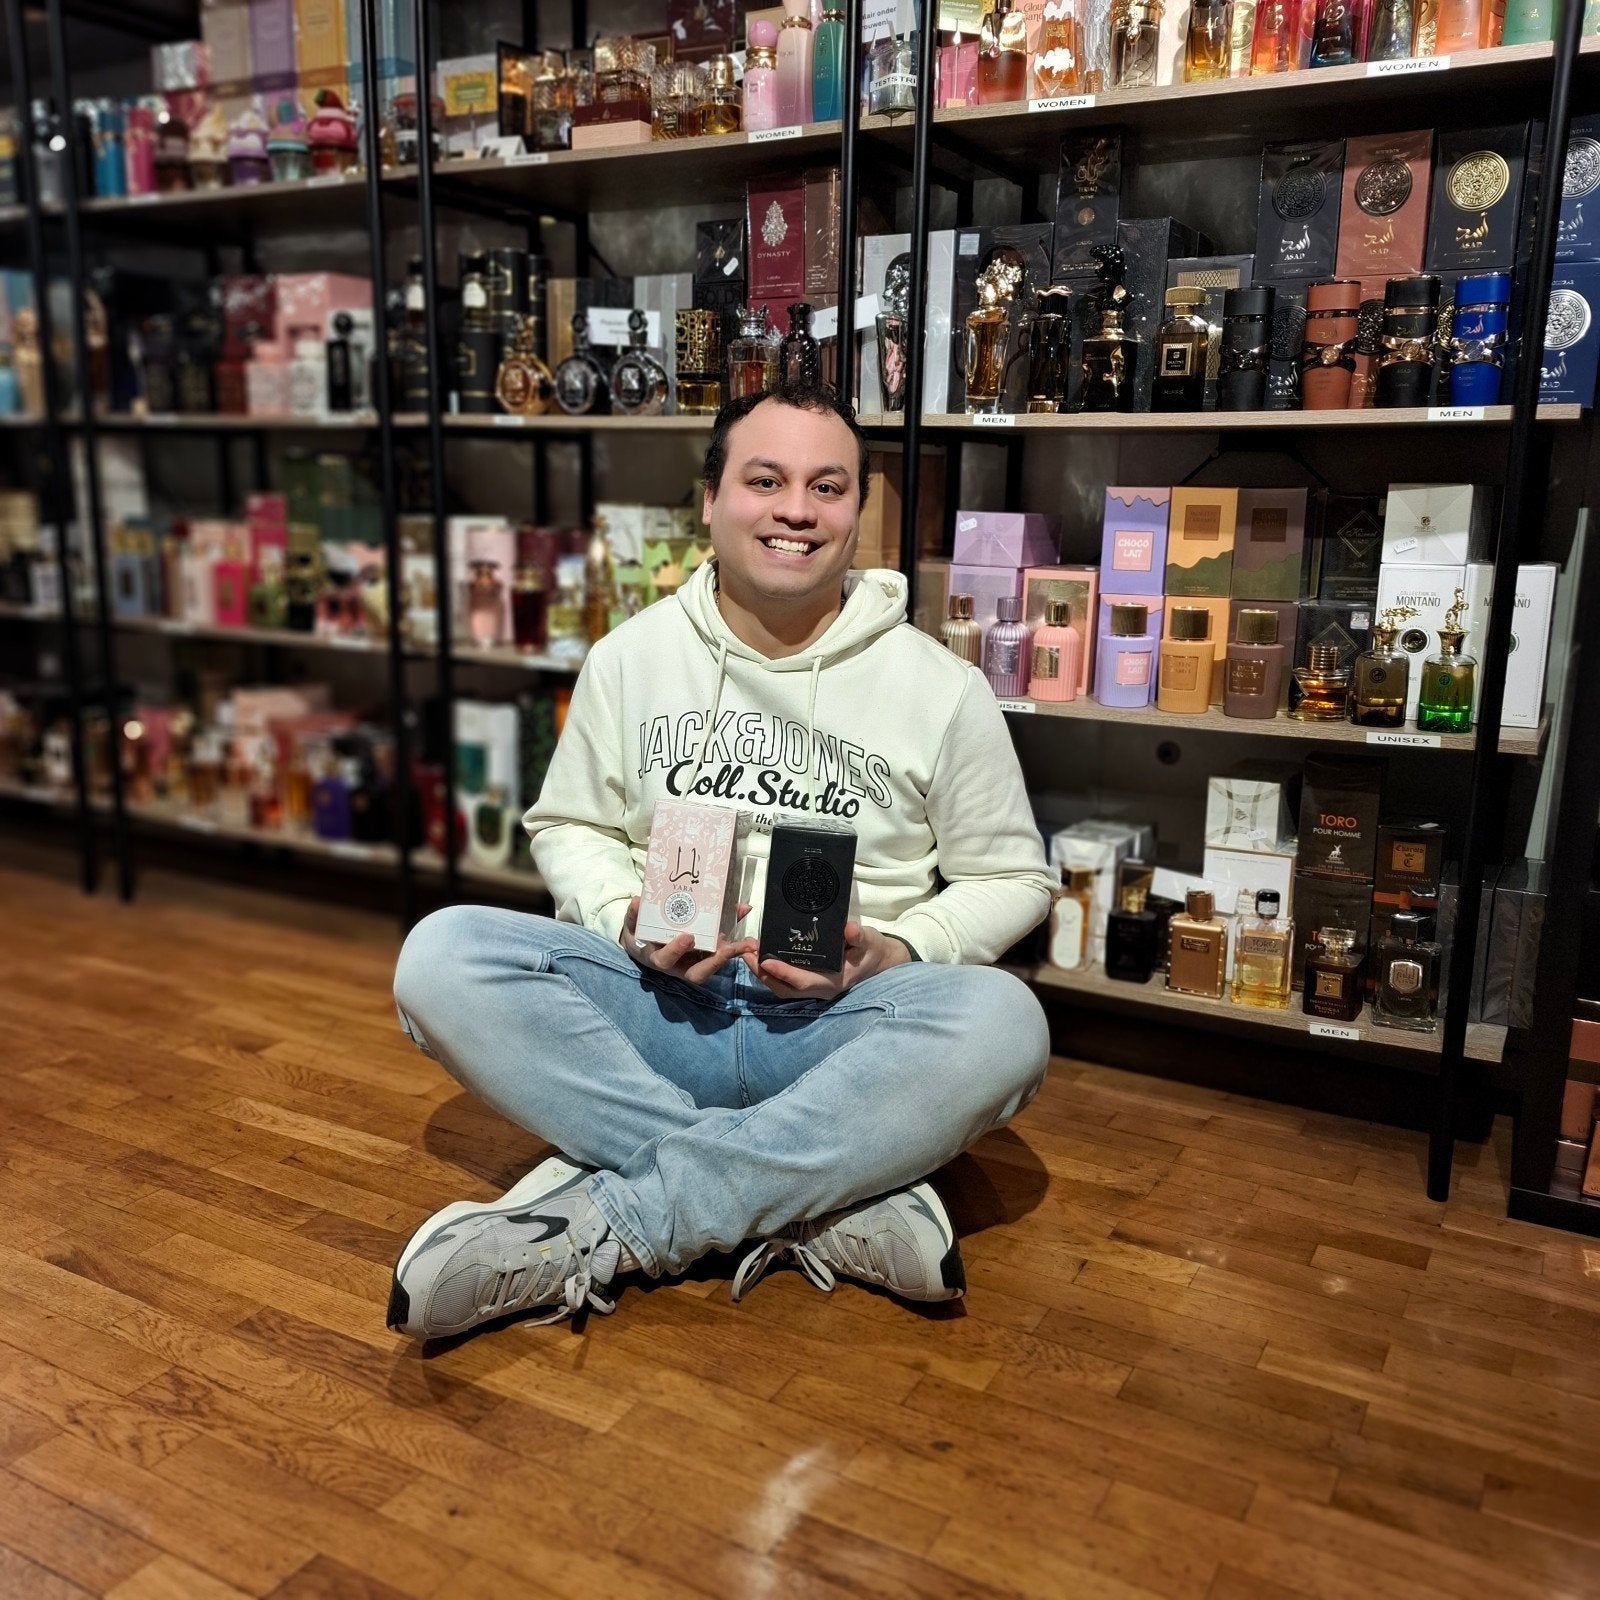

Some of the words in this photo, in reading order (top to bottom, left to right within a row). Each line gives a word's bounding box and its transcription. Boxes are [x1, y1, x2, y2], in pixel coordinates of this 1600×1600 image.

[877, 6, 897, 16] onder
[1378, 60, 1439, 72] WOMEN
[1037, 98, 1087, 109] WOMEN
[755, 129, 795, 139] WOMEN
[1460, 241, 1483, 249] ASAD
[756, 250, 791, 259] DYNASTY
[1284, 252, 1306, 261] ASAD
[1368, 248, 1389, 256] ASAD
[1273, 388, 1293, 396] ASAD
[982, 416, 1007, 424] MEN
[1118, 538, 1150, 548] CHOCO
[1123, 549, 1143, 558] LAIT
[1396, 596, 1441, 607] MONTANO
[1377, 735, 1431, 744] UNISEX
[638, 710, 892, 808] JACK&JONES
[1319, 813, 1357, 828] TORO
[1312, 827, 1332, 835] POUR
[1334, 829, 1362, 839] HOMME
[672, 884, 694, 892] YARA
[791, 943, 813, 951] ASAD
[1320, 1028, 1350, 1037] MEN
